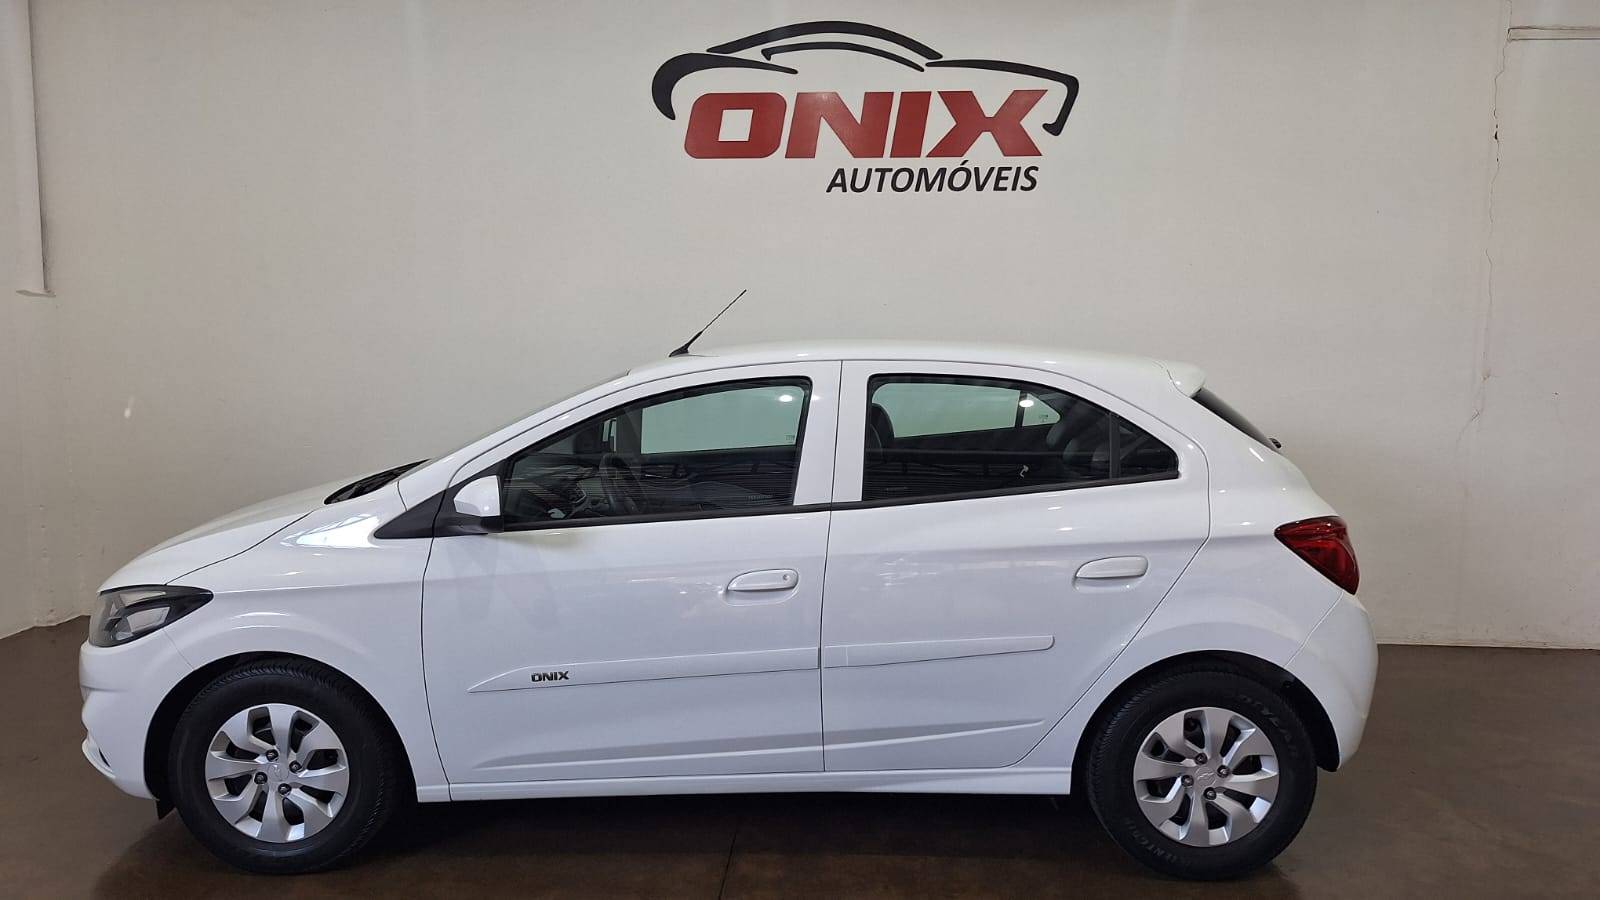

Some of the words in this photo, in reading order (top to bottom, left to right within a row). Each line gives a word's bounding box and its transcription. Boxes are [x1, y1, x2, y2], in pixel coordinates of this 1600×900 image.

[684, 90, 1048, 159] ONIX
[826, 160, 1039, 193] AUTOMÓVEIS
[531, 671, 570, 683] ONIX
